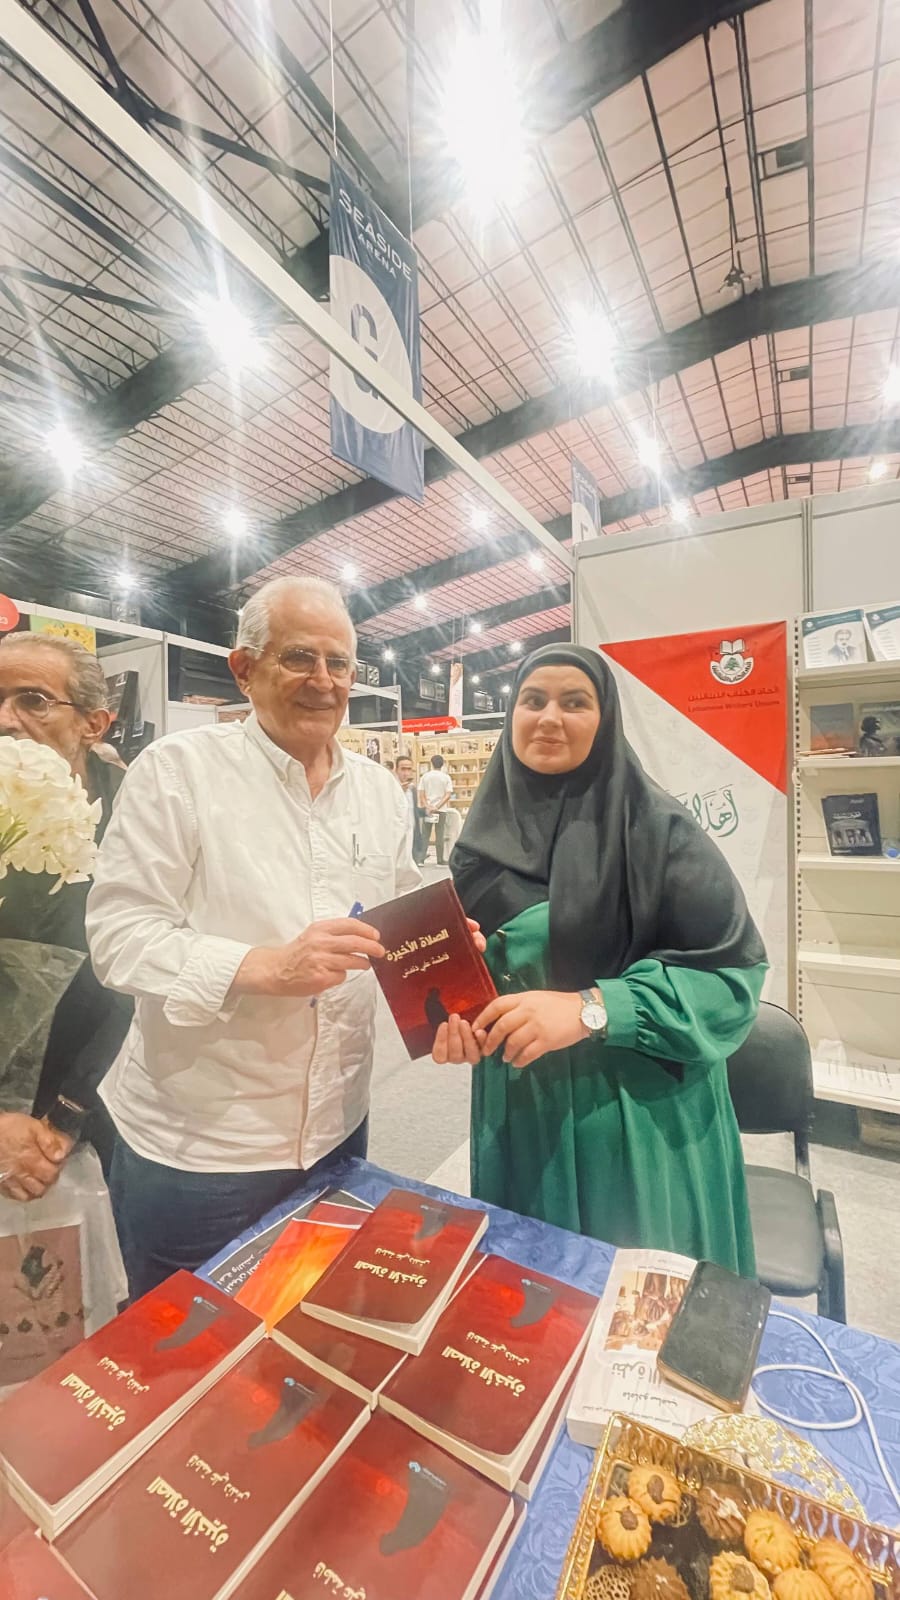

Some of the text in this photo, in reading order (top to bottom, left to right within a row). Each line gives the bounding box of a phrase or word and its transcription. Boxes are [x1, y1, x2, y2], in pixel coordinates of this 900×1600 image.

[339, 188, 413, 282] SEASIDE
[358, 232, 398, 280] ARENA
[385, 928, 450, 962] الصلاة الأخيرة
[430, 952, 450, 965] فاطمة
[419, 961, 432, 972] علي
[353, 1260, 428, 1288] الصلاة الأخيرة
[374, 1247, 431, 1267] فاطمة علي دندش
[224, 1272, 247, 1293] البيان
[466, 1331, 530, 1366] فاطمة علي دندش
[97, 1356, 150, 1395] فاطمة علي دندش
[441, 1346, 526, 1397] الصلاة الأخيرة
[611, 1361, 646, 1380] نظرة
[60, 1373, 126, 1431] الصلاة الأخيرة
[185, 1454, 250, 1503] فاطمة علي دندش
[146, 1476, 229, 1553] الصلاة الأخيرة
[312, 1561, 344, 1595] فاطمة
